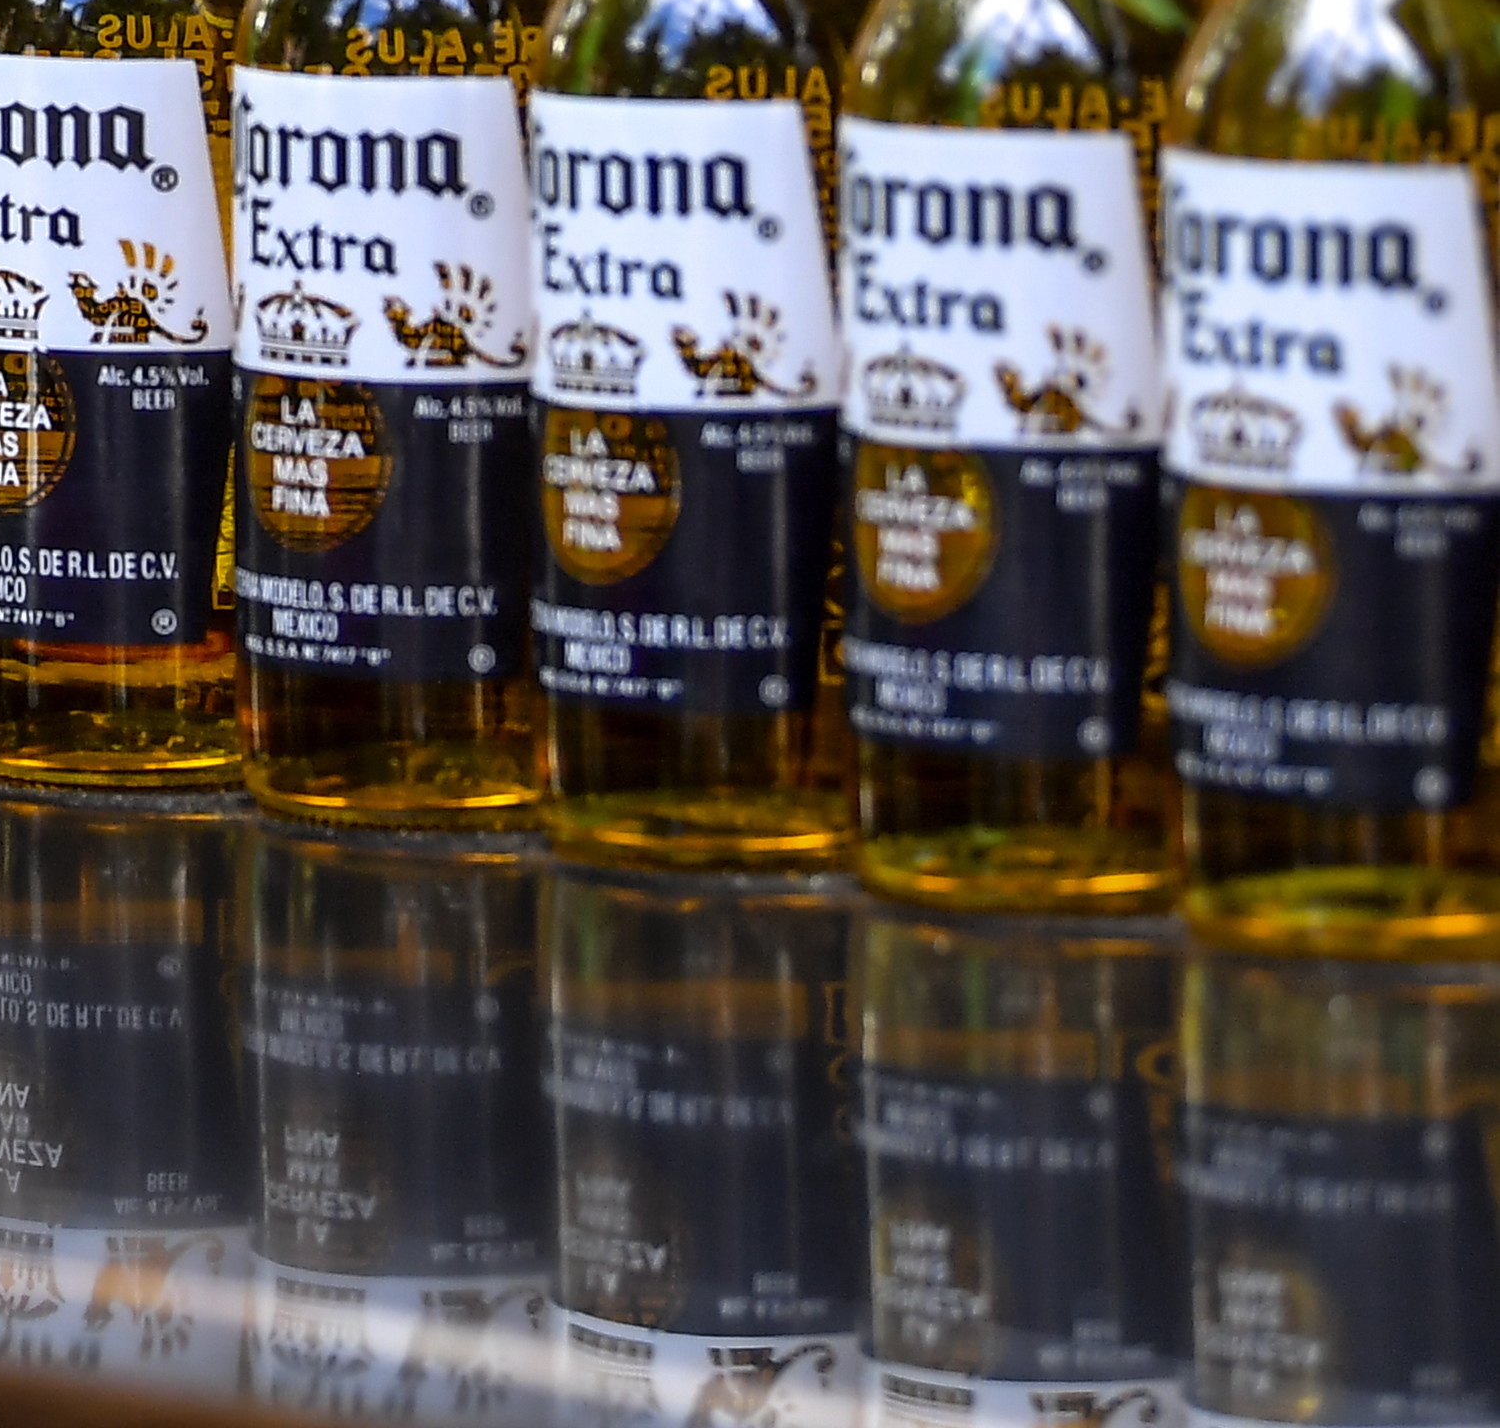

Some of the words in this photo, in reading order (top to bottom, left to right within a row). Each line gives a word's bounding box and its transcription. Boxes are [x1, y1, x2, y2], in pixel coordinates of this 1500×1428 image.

[251, 198, 398, 275] Extra
[545, 223, 683, 301] Extra
[98, 366, 130, 386] Alc.
[132, 366, 177, 386] 4.5%
[177, 366, 210, 386] Vol.
[131, 389, 176, 410] BEER
[280, 394, 316, 425] LA
[251, 421, 366, 459] CERVEZA
[272, 455, 328, 487] MAS
[271, 485, 331, 518] FINA
[18, 549, 36, 574] S.
[38, 550, 62, 577] DE
[68, 551, 106, 578] R.L.
[109, 552, 137, 579] DE
[141, 552, 180, 580] C.V.
